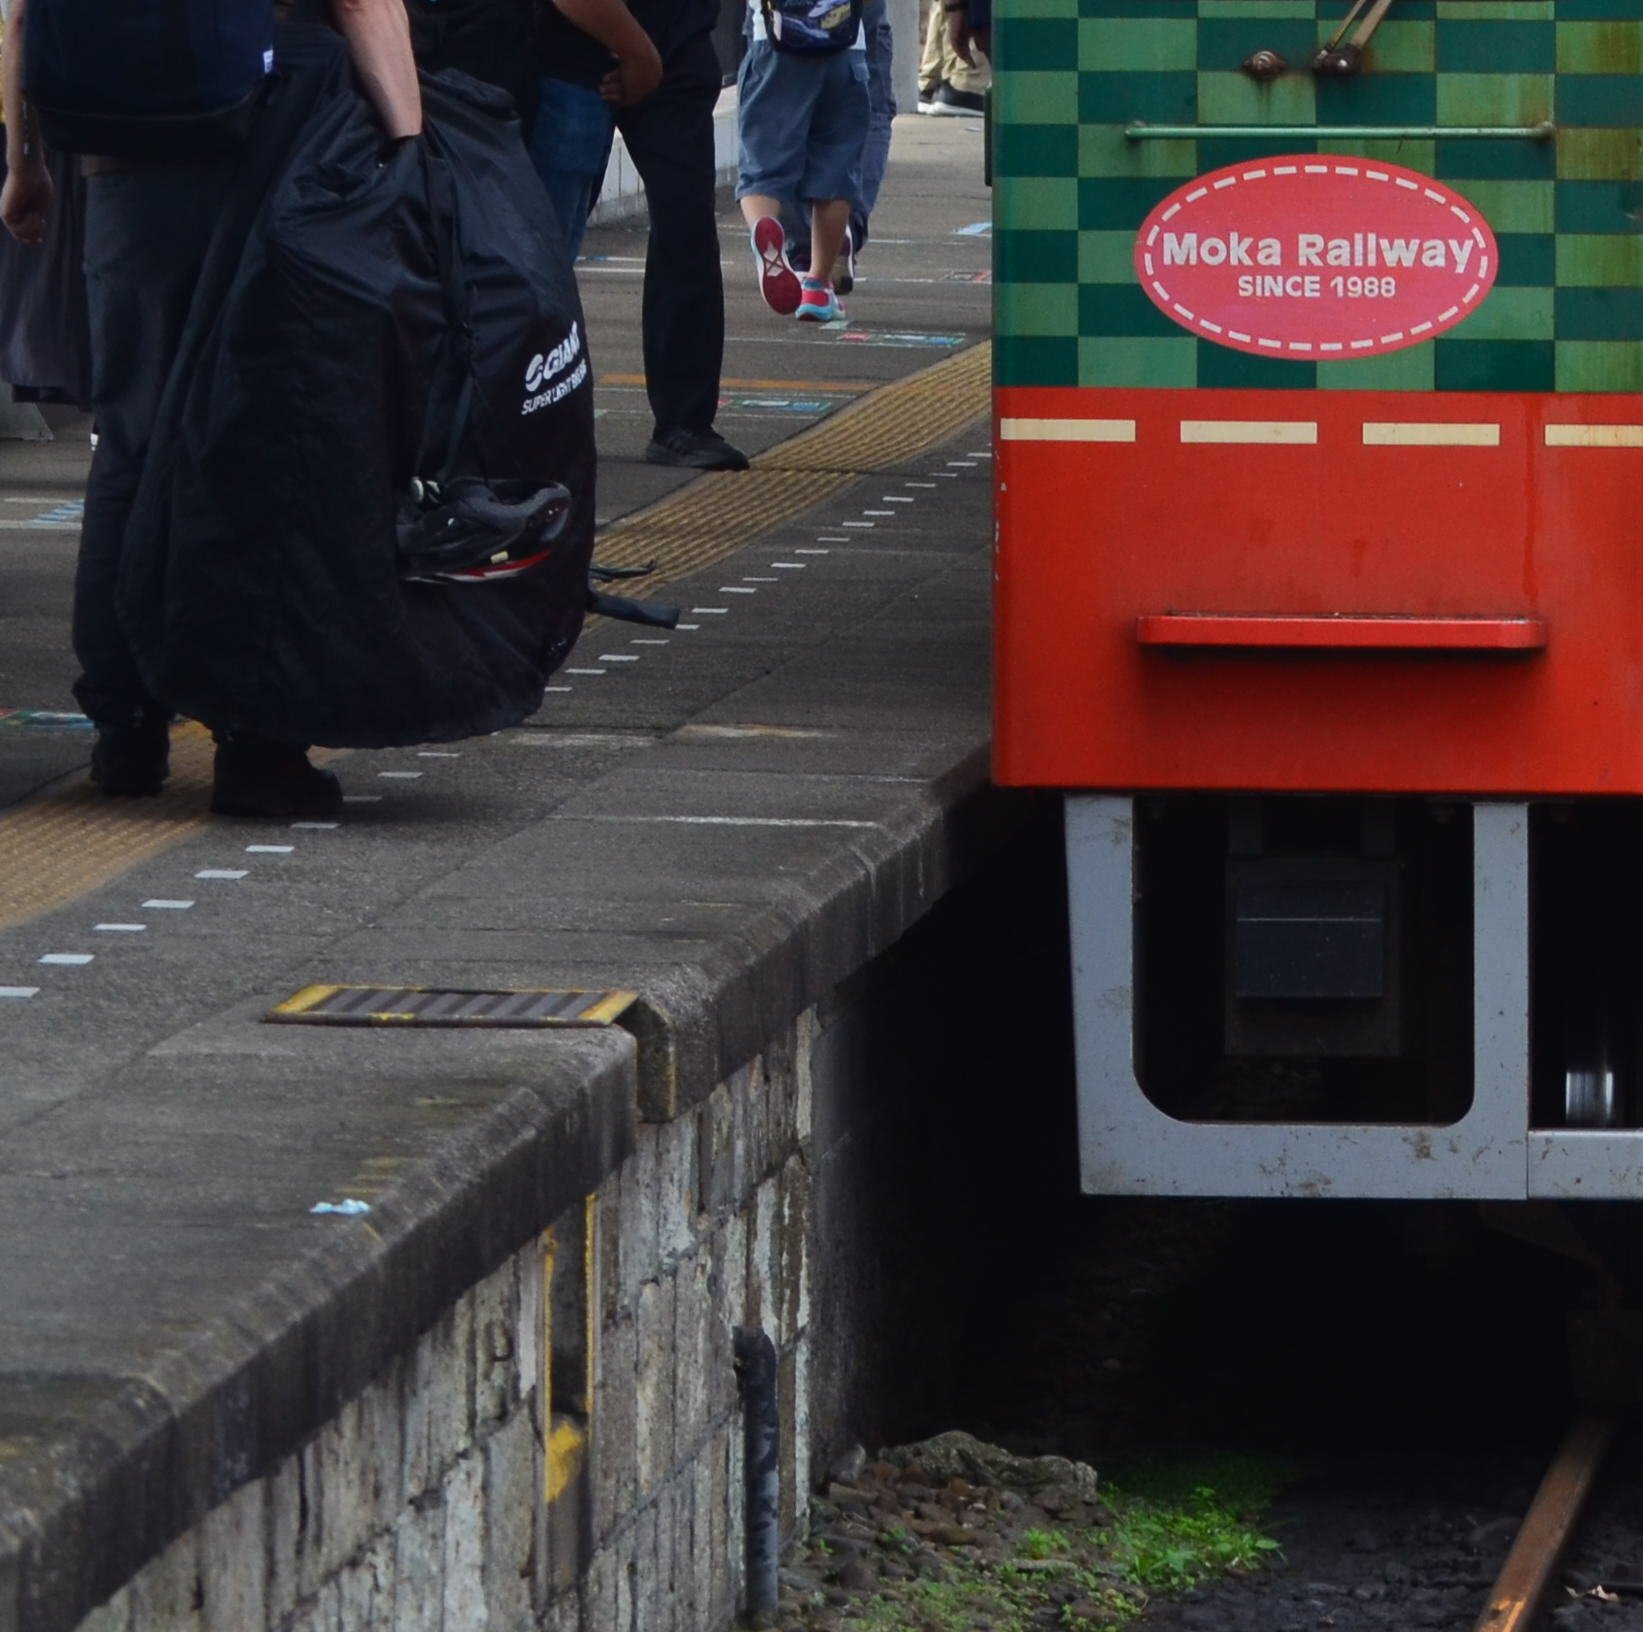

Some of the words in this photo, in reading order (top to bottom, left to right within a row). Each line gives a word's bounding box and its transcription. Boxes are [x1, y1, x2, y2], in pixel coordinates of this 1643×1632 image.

[1162, 232, 1282, 267] Moka
[1298, 232, 1475, 274] Railway
[1238, 275, 1321, 298] SINCE
[1330, 276, 1397, 298] 1988
